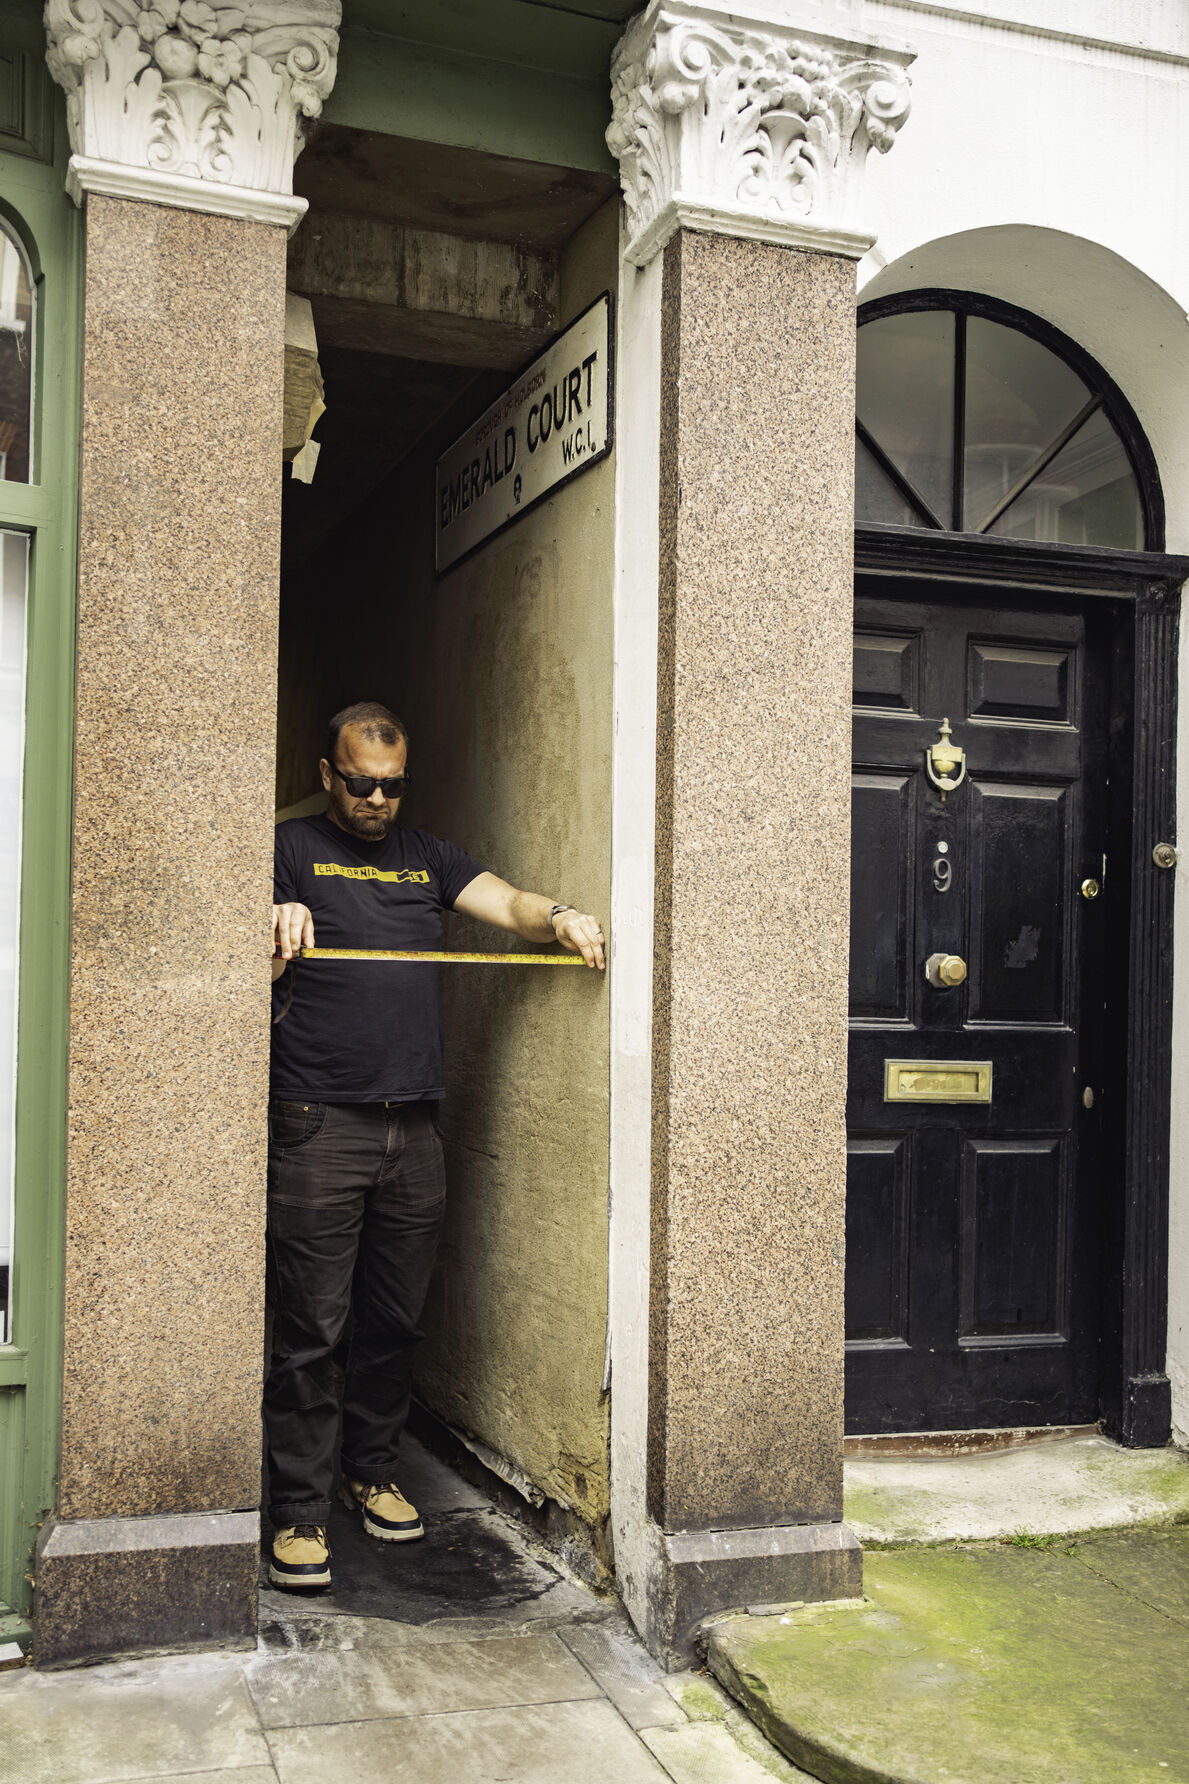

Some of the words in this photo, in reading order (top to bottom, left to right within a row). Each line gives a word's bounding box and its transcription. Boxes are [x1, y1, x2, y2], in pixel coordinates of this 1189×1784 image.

[515, 368, 546, 408] HOLBORN
[440, 426, 516, 530] EMERALD
[527, 351, 598, 453] COURT
[933, 858, 952, 892] 9
